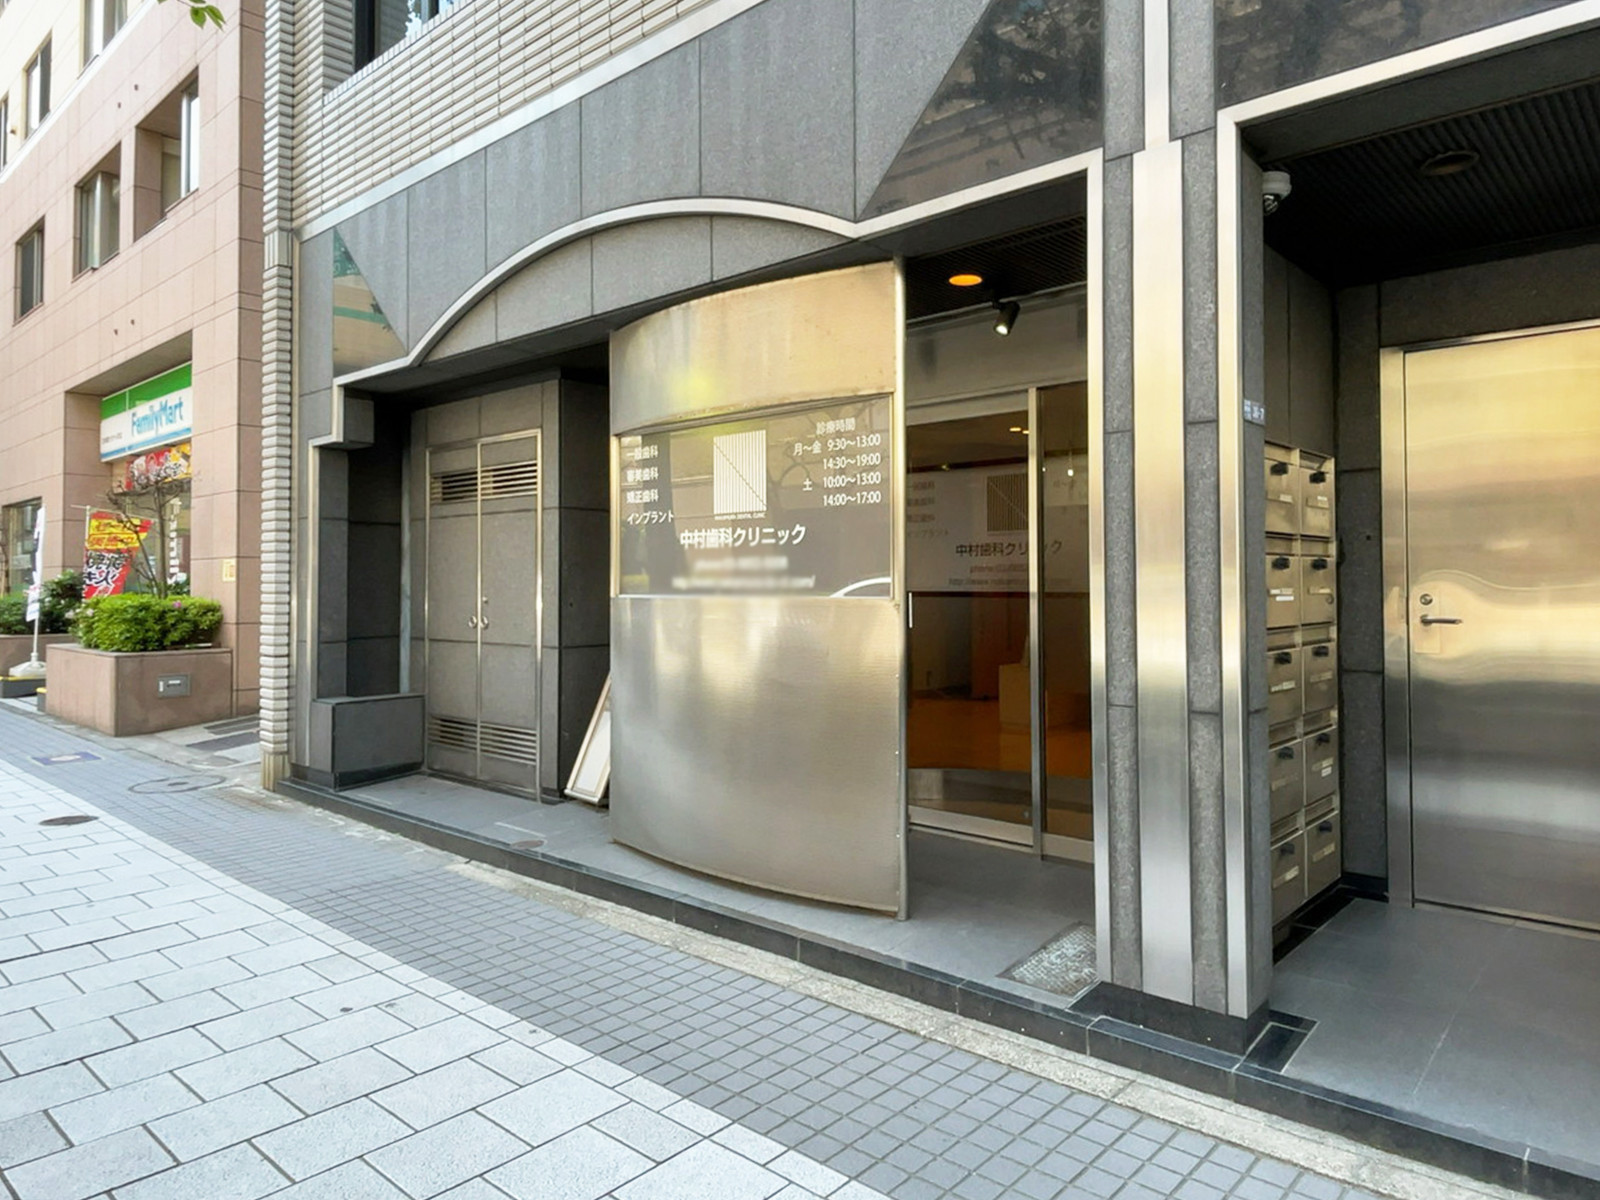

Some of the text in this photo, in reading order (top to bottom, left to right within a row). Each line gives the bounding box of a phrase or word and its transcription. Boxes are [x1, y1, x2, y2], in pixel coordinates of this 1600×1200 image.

[131, 397, 184, 437] FamilyMart
[802, 478, 813, 491] 土
[680, 524, 806, 549] 中村歯科クリニック
